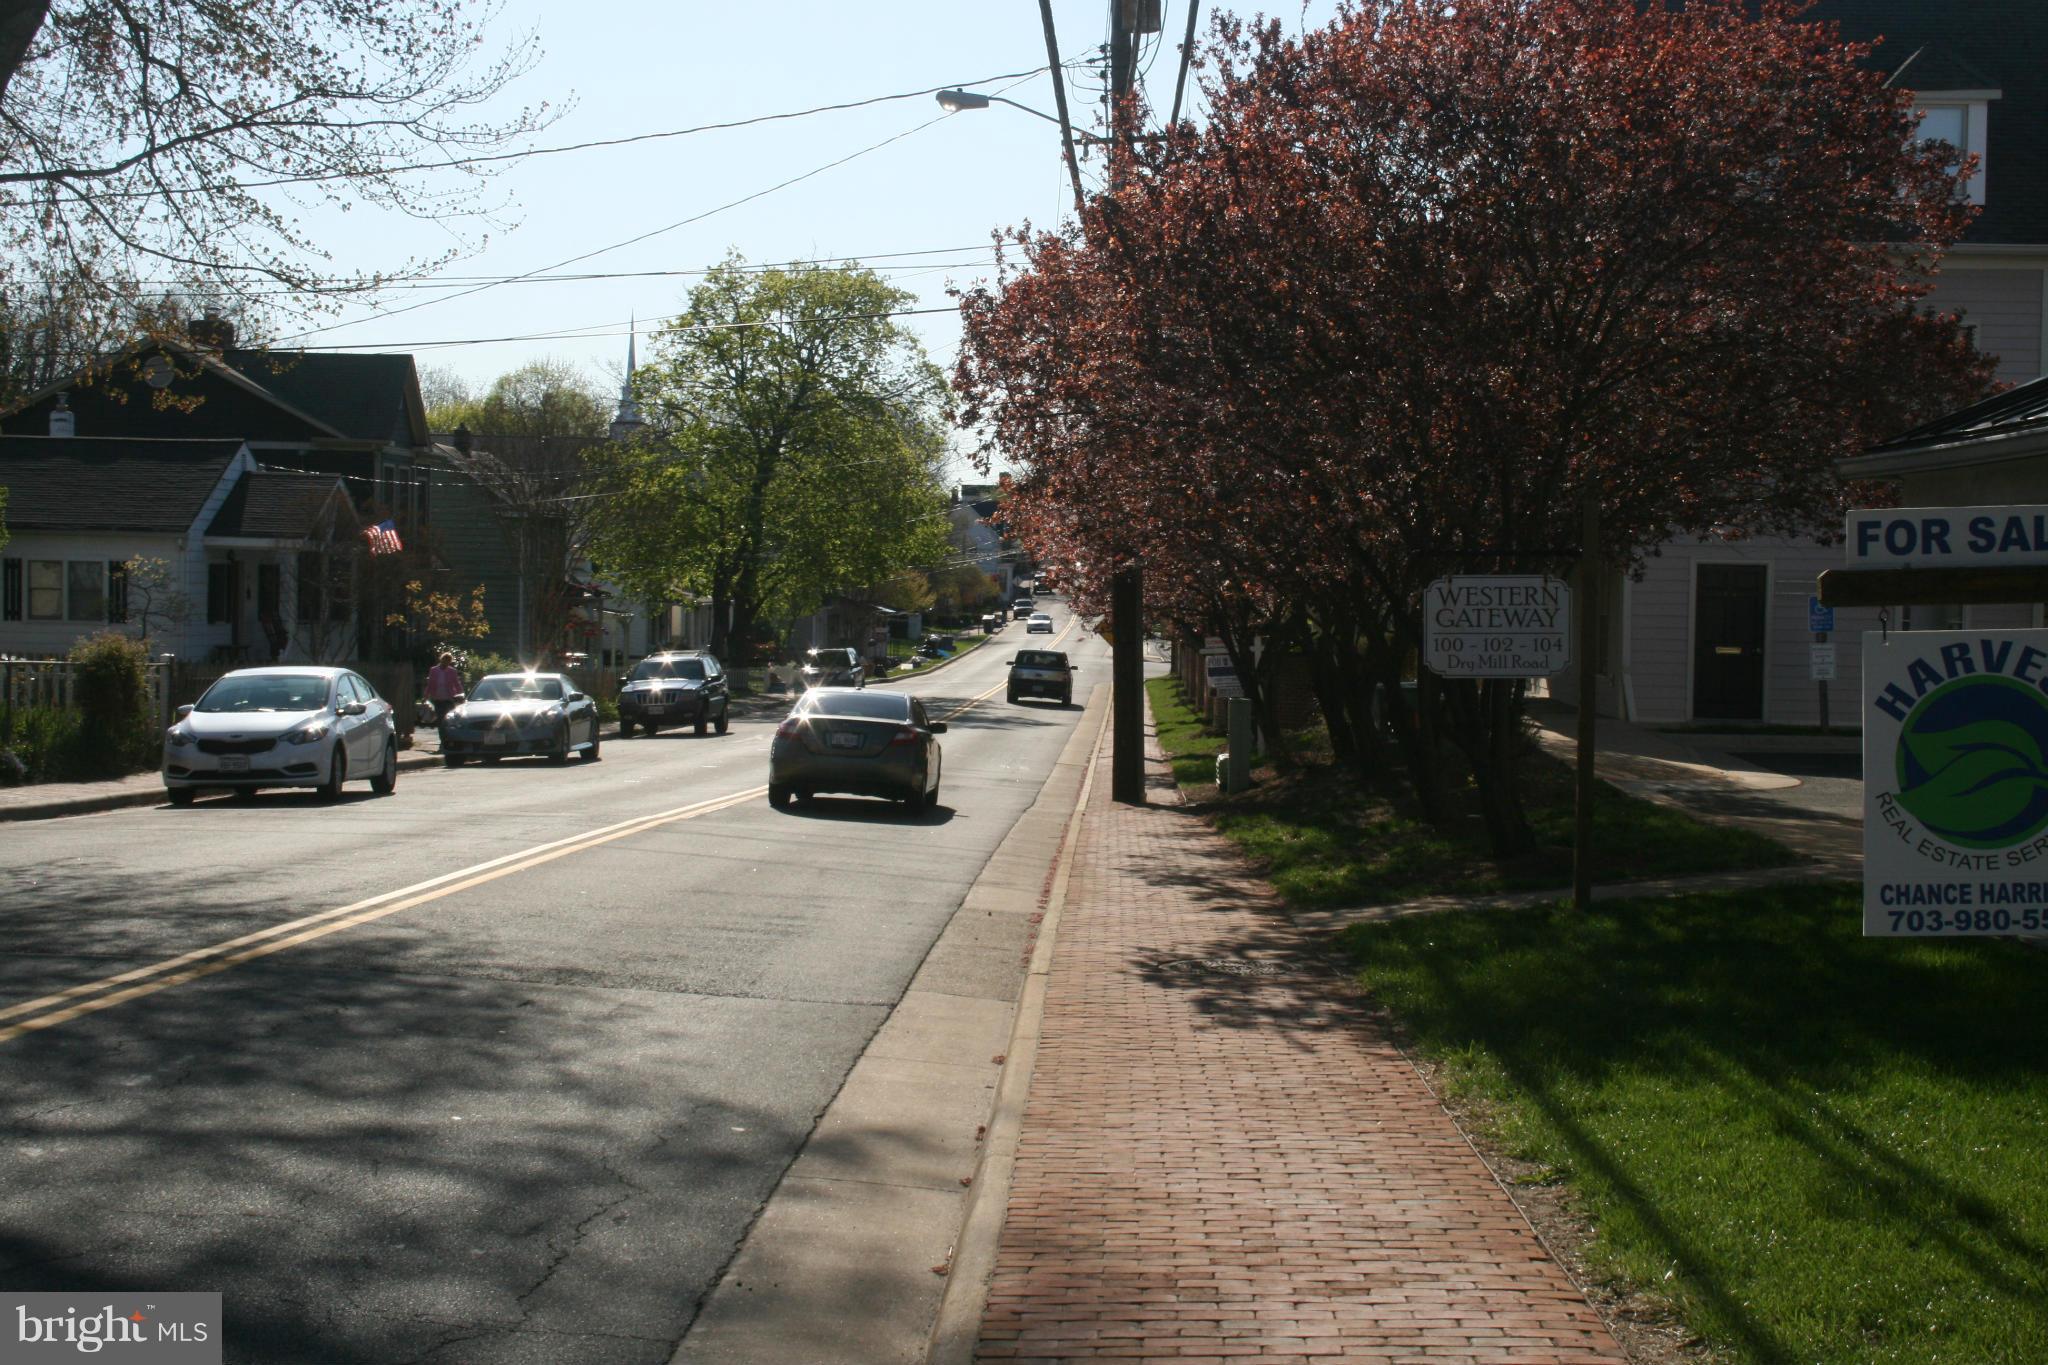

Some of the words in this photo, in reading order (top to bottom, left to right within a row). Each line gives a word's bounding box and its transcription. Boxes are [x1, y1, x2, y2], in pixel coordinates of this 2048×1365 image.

[1857, 518, 1953, 557] FOR
[1436, 586, 1560, 607] WESTERN
[1435, 607, 1561, 628] GATEWAY
[1433, 637, 1464, 652] 100
[1484, 637, 1513, 652] 102
[1534, 637, 1563, 652] 104
[1447, 654, 1474, 672] Dry
[1478, 654, 1508, 669] Mill
[1512, 654, 1549, 669] Road
[1874, 639, 2048, 722] HARVE
[1875, 791, 1914, 845] REAL
[1916, 838, 2001, 871] ESTATE
[2006, 834, 2048, 867] SER
[1880, 883, 1973, 906] CHANCE
